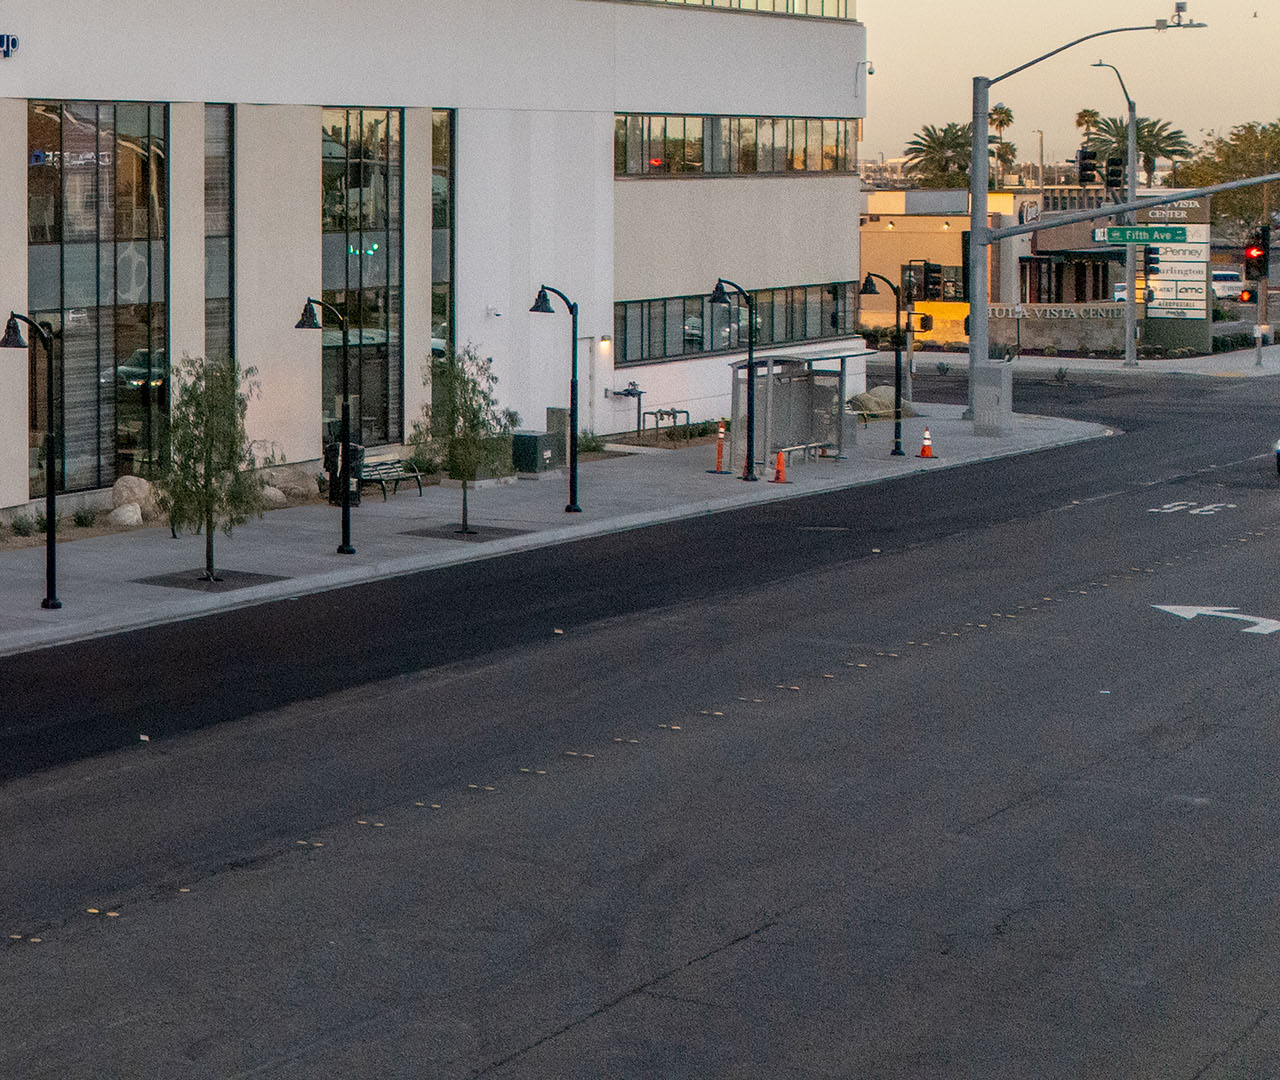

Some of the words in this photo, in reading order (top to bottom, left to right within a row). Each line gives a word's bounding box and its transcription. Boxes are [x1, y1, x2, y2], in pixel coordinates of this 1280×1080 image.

[1173, 200, 1200, 208] VISTA
[1148, 210, 1188, 218] CENTER
[1126, 230, 1149, 240] Fifth
[1153, 230, 1172, 240] Ave
[1159, 246, 1202, 258] CPenney
[1159, 266, 1204, 276] urlington
[988, 307, 1030, 319] ULA
[1033, 307, 1077, 319] VISTA
